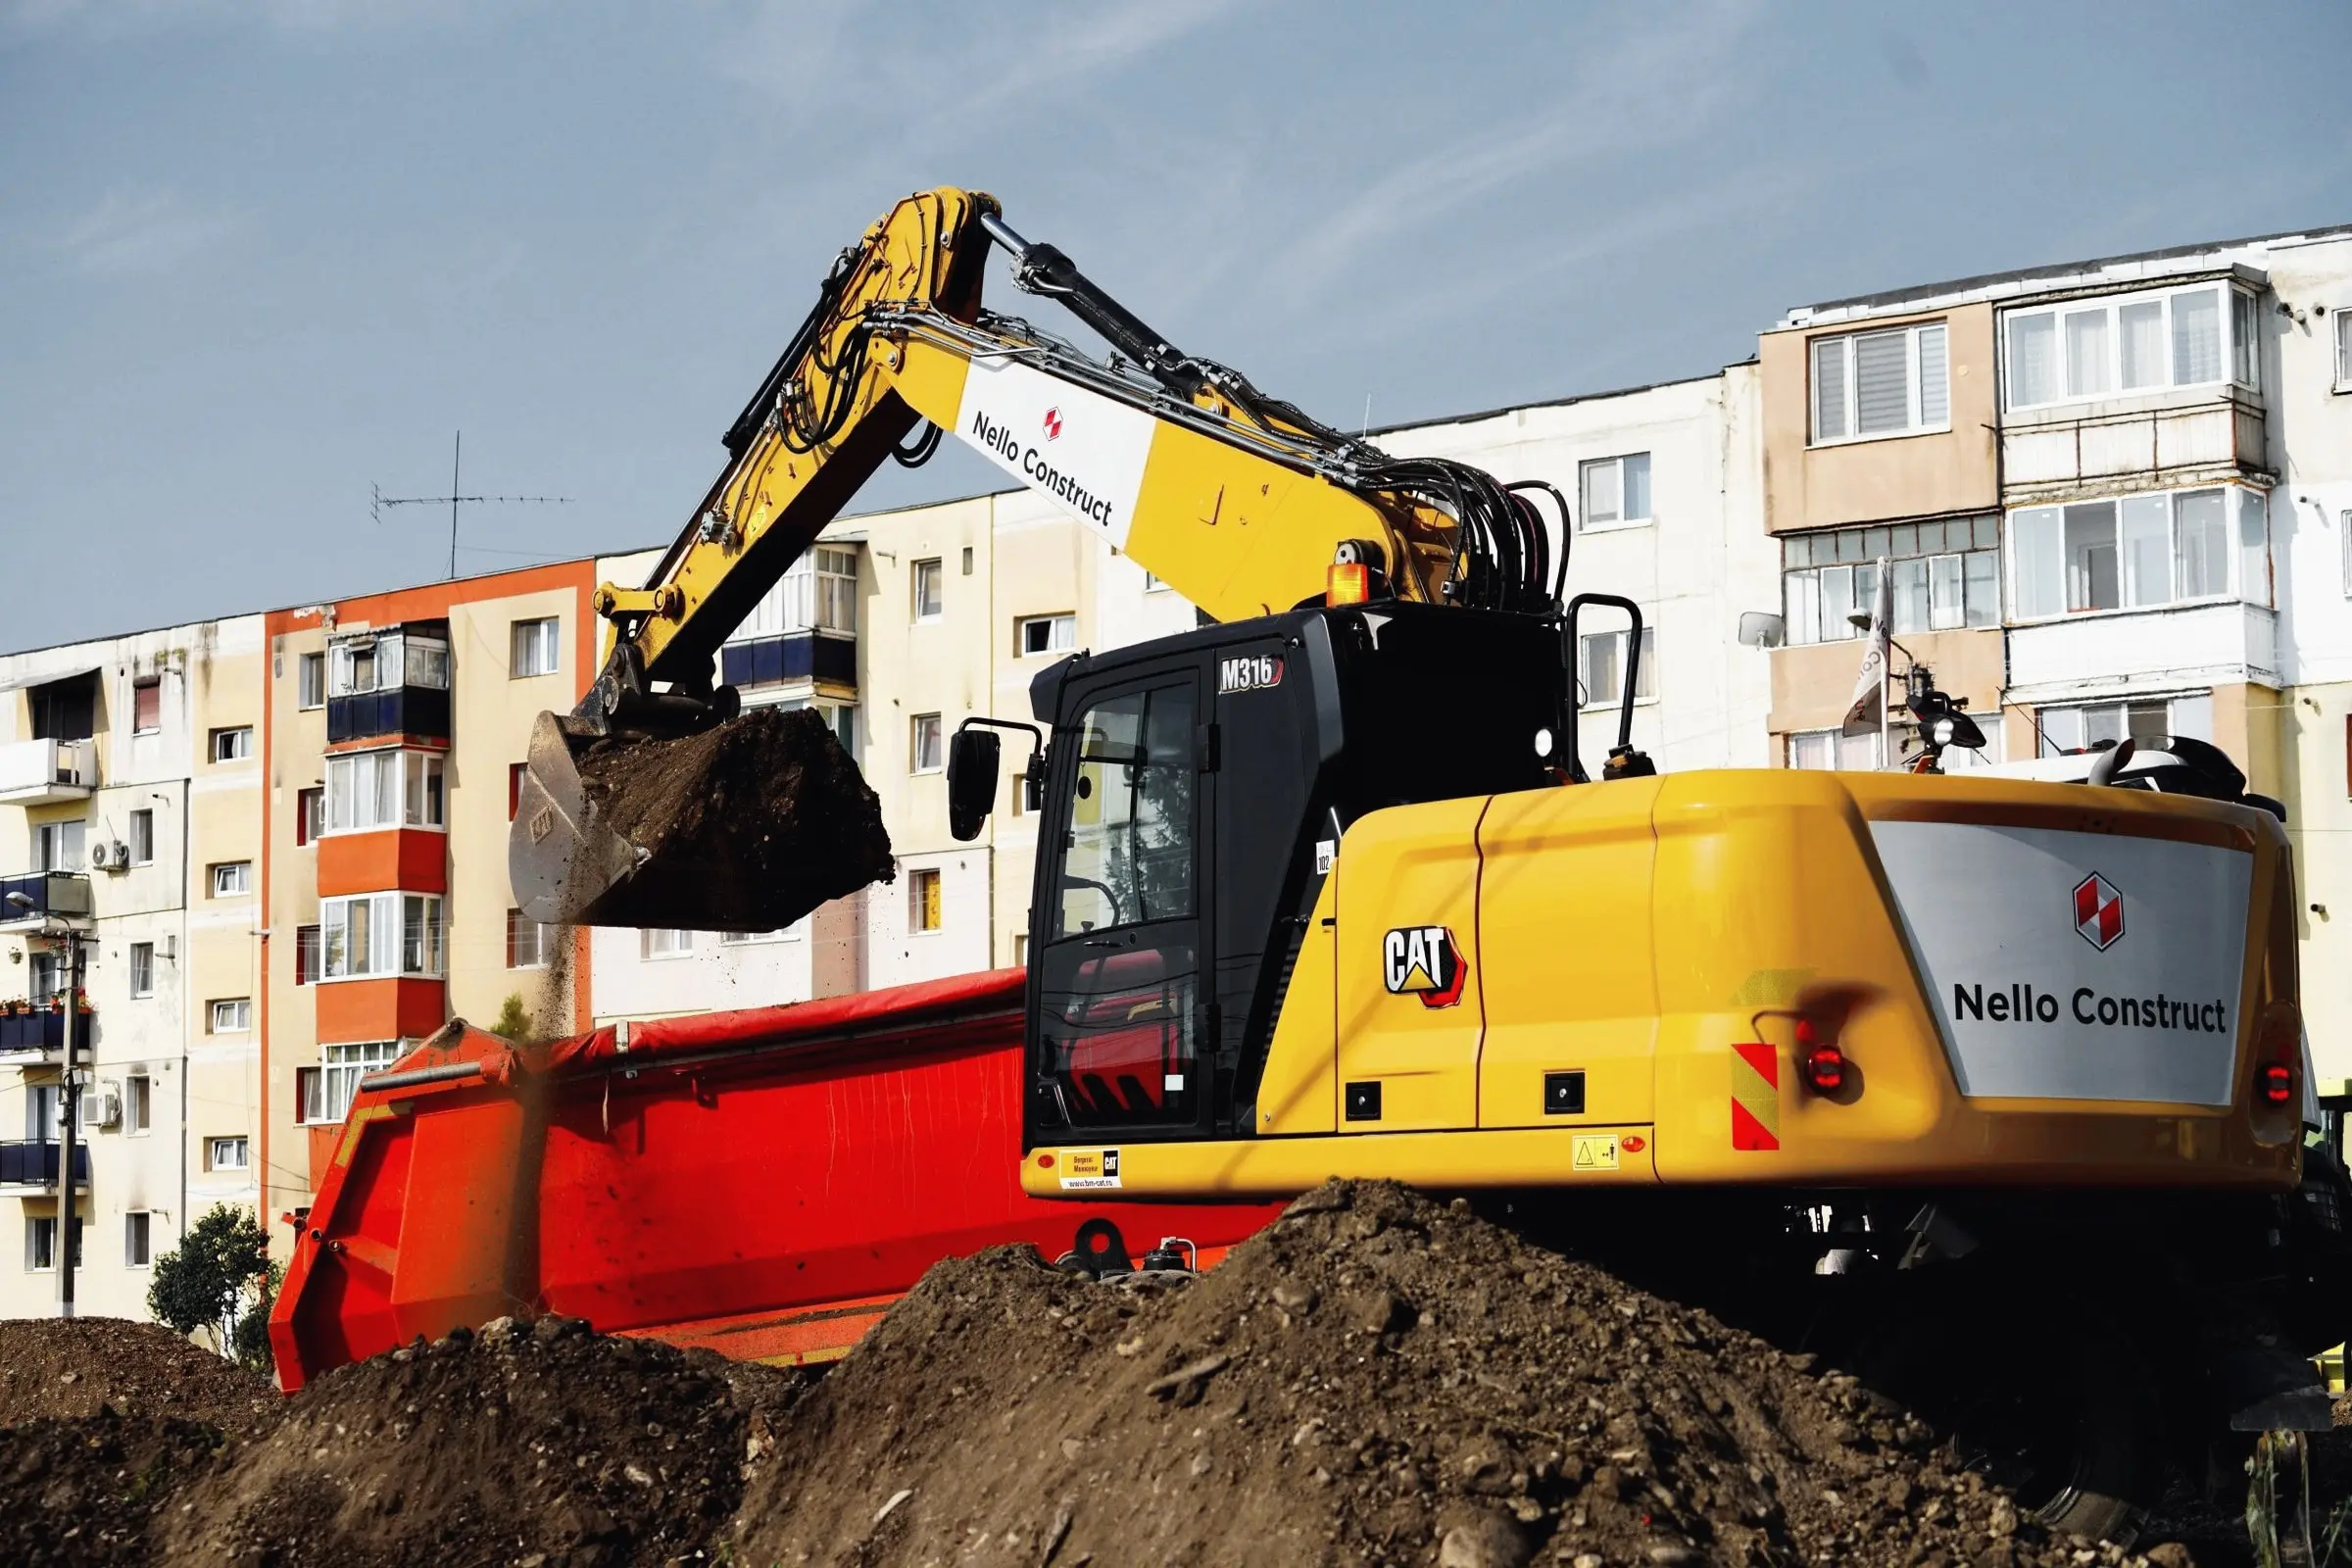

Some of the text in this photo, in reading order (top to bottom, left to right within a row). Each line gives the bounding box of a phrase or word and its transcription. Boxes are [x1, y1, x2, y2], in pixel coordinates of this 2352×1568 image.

[972, 410, 1112, 527] Nello Construct
[1222, 657, 1273, 691] M316
[1318, 855, 1330, 871] 102
[1385, 928, 1445, 992] CAT
[1954, 983, 2226, 1034] Nello Construct
[1104, 1156, 1116, 1169] CAT
